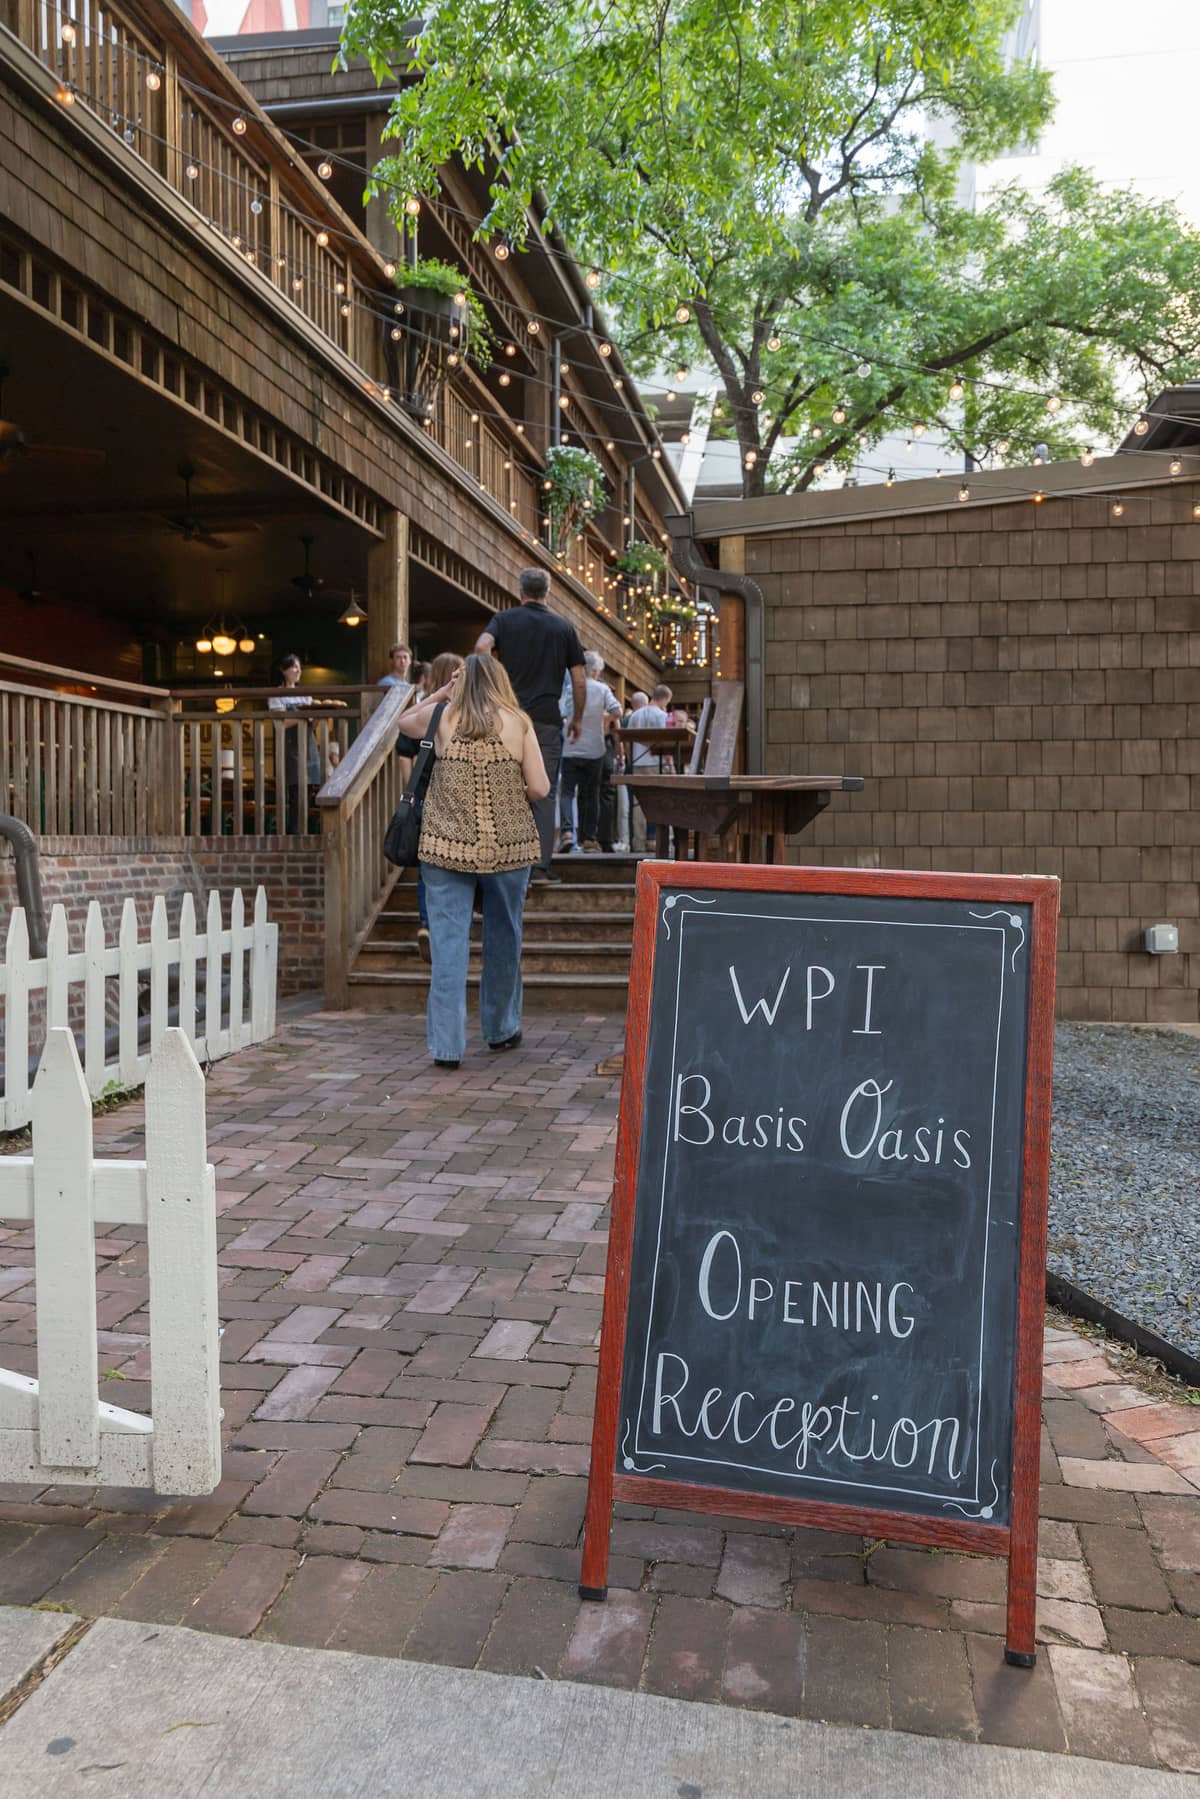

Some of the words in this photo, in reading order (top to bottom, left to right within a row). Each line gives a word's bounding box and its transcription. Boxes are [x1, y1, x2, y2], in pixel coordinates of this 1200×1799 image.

[729, 965, 886, 1034] WPI
[673, 1073, 807, 1152] Basis
[839, 1078, 971, 1169] Oasis
[652, 1352, 962, 1480] Reception
